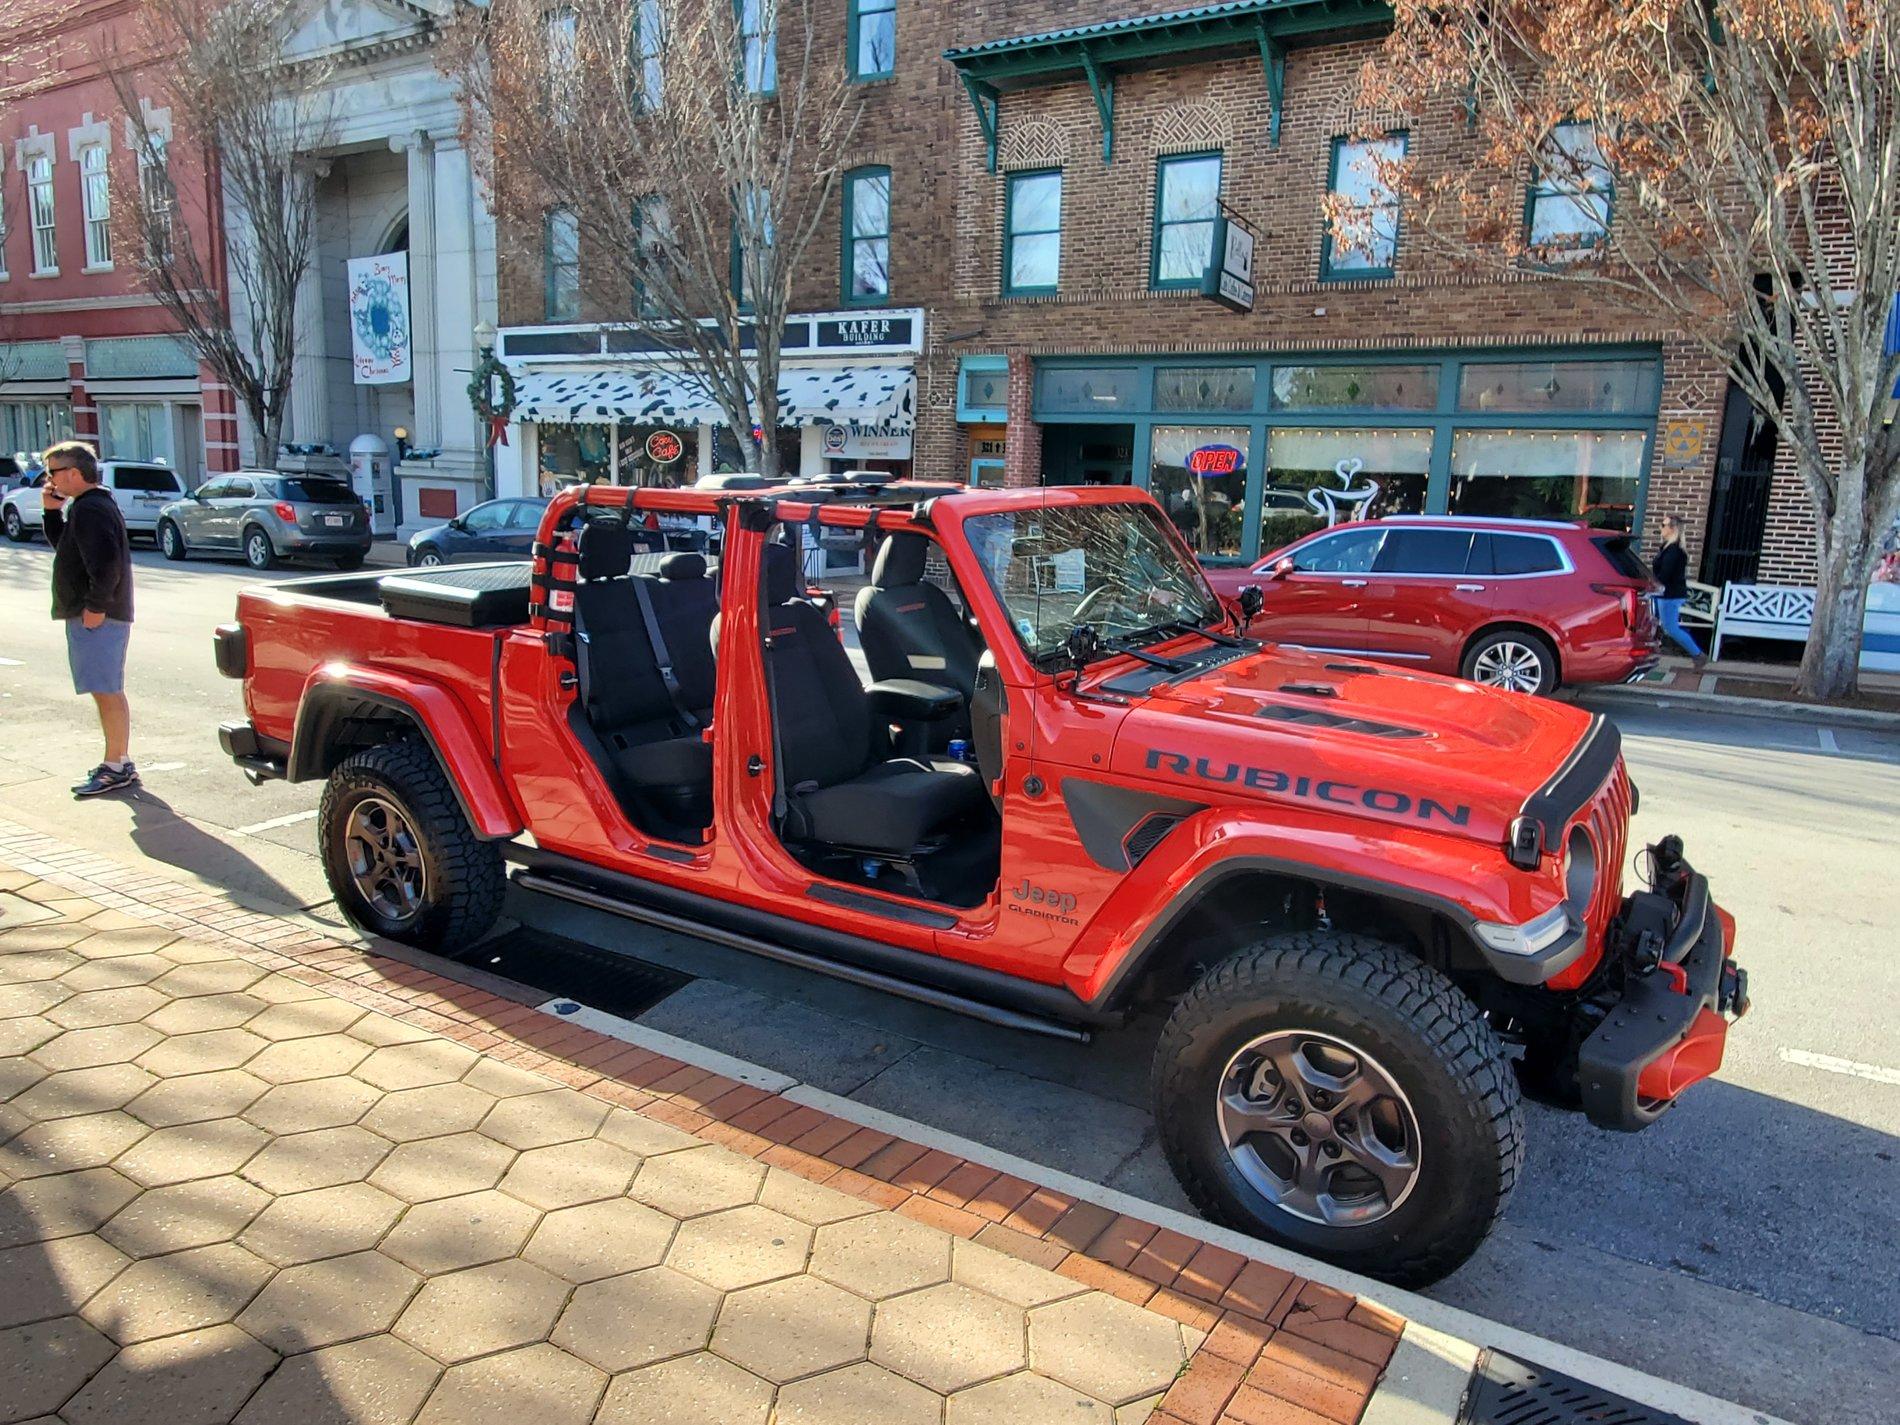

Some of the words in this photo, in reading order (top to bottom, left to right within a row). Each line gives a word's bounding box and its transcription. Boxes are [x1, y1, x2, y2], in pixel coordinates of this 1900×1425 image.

[838, 320, 890, 334] KAFER
[843, 333, 885, 341] BUILDING
[650, 436, 674, 447] Cow
[1191, 450, 1237, 472] OPEN
[1145, 749, 1470, 826] RUBICON
[1012, 879, 1077, 914] Jeep
[1008, 904, 1079, 926] GLADIATOR
